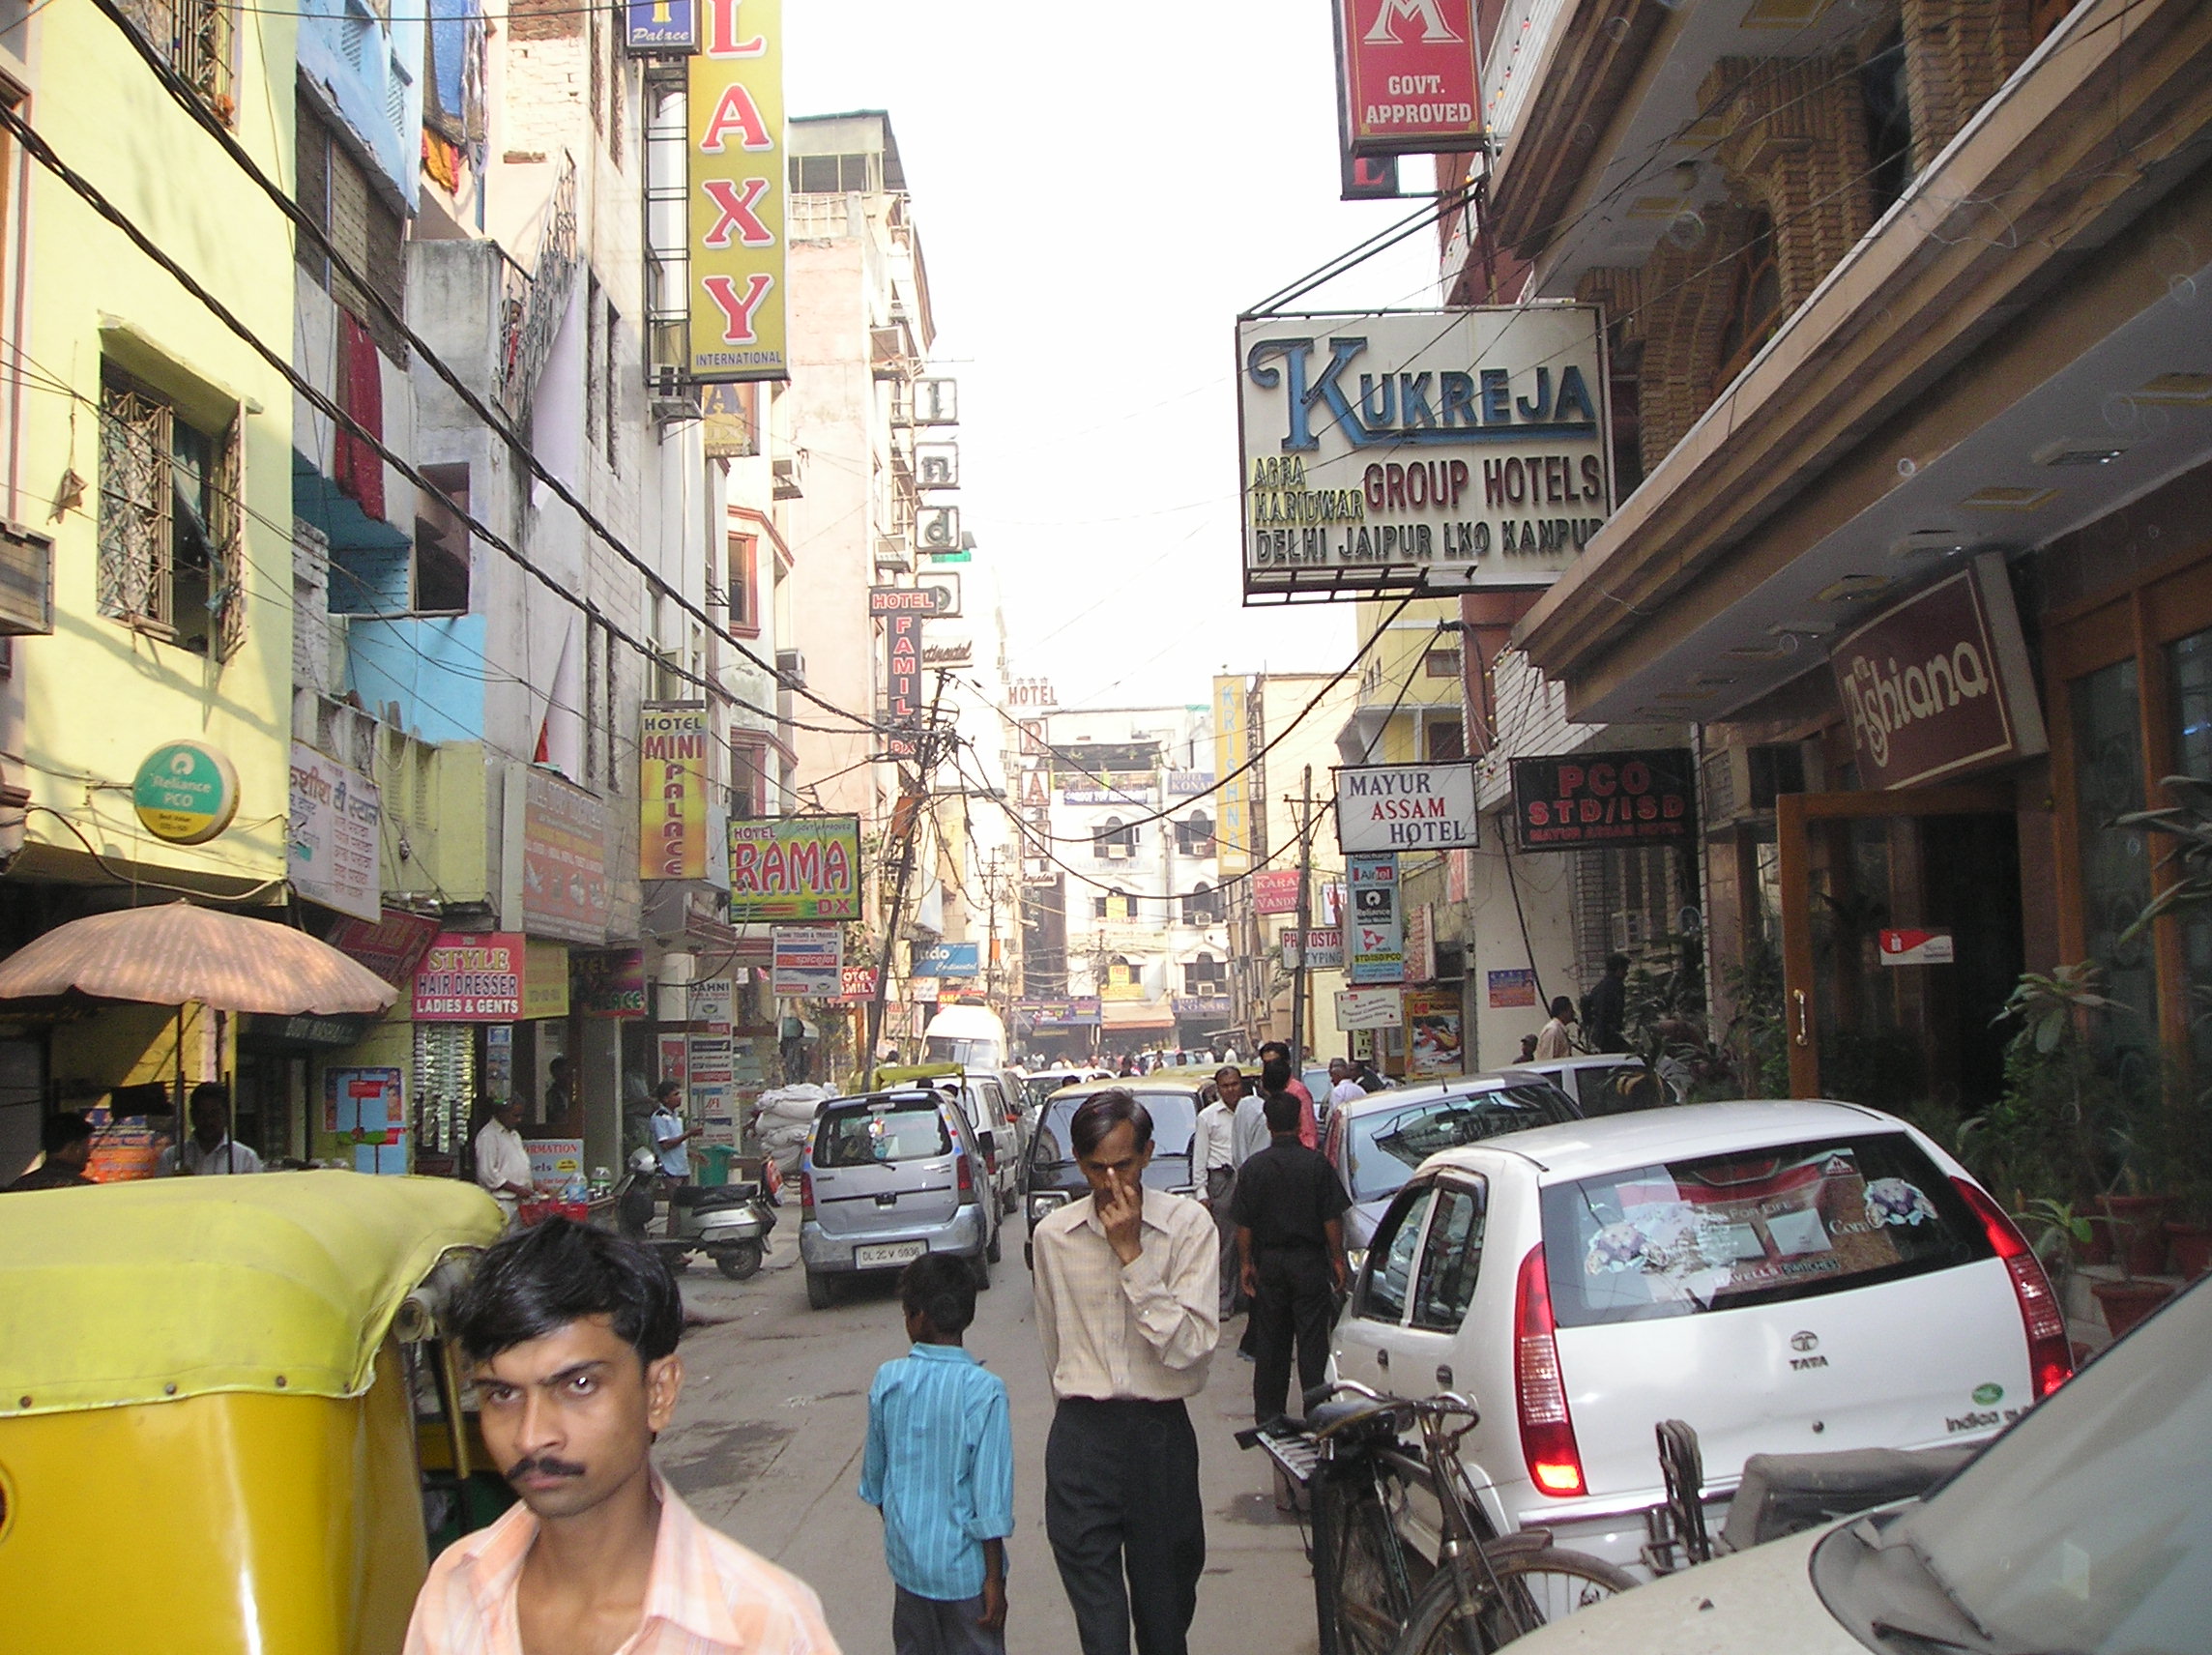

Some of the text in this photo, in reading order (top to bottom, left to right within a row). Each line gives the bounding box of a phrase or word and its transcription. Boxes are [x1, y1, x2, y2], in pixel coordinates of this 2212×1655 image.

[631, 27, 689, 44] Palace
[1387, 74, 1446, 96] GOVT.
[1366, 102, 1472, 125] APPROVED
[695, 349, 783, 366] INTERNATIONAL
[1246, 335, 1597, 451] KUKREJA
[1254, 454, 1306, 488] AGRA
[1363, 453, 1601, 512] GROUP HOTELS
[1254, 489, 1364, 523] HARIDWAR
[1256, 527, 1327, 563] DELHI
[1337, 523, 1433, 559] JAIPUR
[1443, 520, 1491, 558] LKO
[872, 592, 935, 610] HOTEL
[892, 616, 916, 728] FAMIL
[1007, 685, 1059, 706] HOTEL
[1844, 641, 1989, 768] Ashiana
[644, 717, 702, 732] HOTEL
[644, 735, 703, 760] MINI
[1221, 684, 1242, 853] KRISHNA
[1557, 761, 1651, 798] PCO
[151, 775, 212, 794] Reliance
[1350, 772, 1431, 797] MAYUR
[163, 794, 194, 808] PCO
[1371, 797, 1445, 821] ASSAM
[1528, 794, 1685, 827] STD/ISD
[663, 763, 684, 877] PALACE
[733, 826, 776, 841] HOTEL
[1390, 820, 1467, 844] HOTEL
[735, 839, 851, 894] RAMA
[1256, 876, 1299, 889] KARA
[817, 898, 852, 915] DX
[1283, 931, 1343, 948] PHTOSTAT
[428, 946, 510, 973] STYLE
[417, 974, 451, 998] HAIR
[453, 973, 518, 997] DRESSER
[842, 971, 872, 982] OTEL
[842, 982, 875, 994] MILY
[416, 999, 519, 1014] LADIES & GENTS
[525, 1144, 578, 1154] ORMATION
[1790, 1352, 1829, 1371] TATA
[1945, 1410, 2000, 1433] Indica
